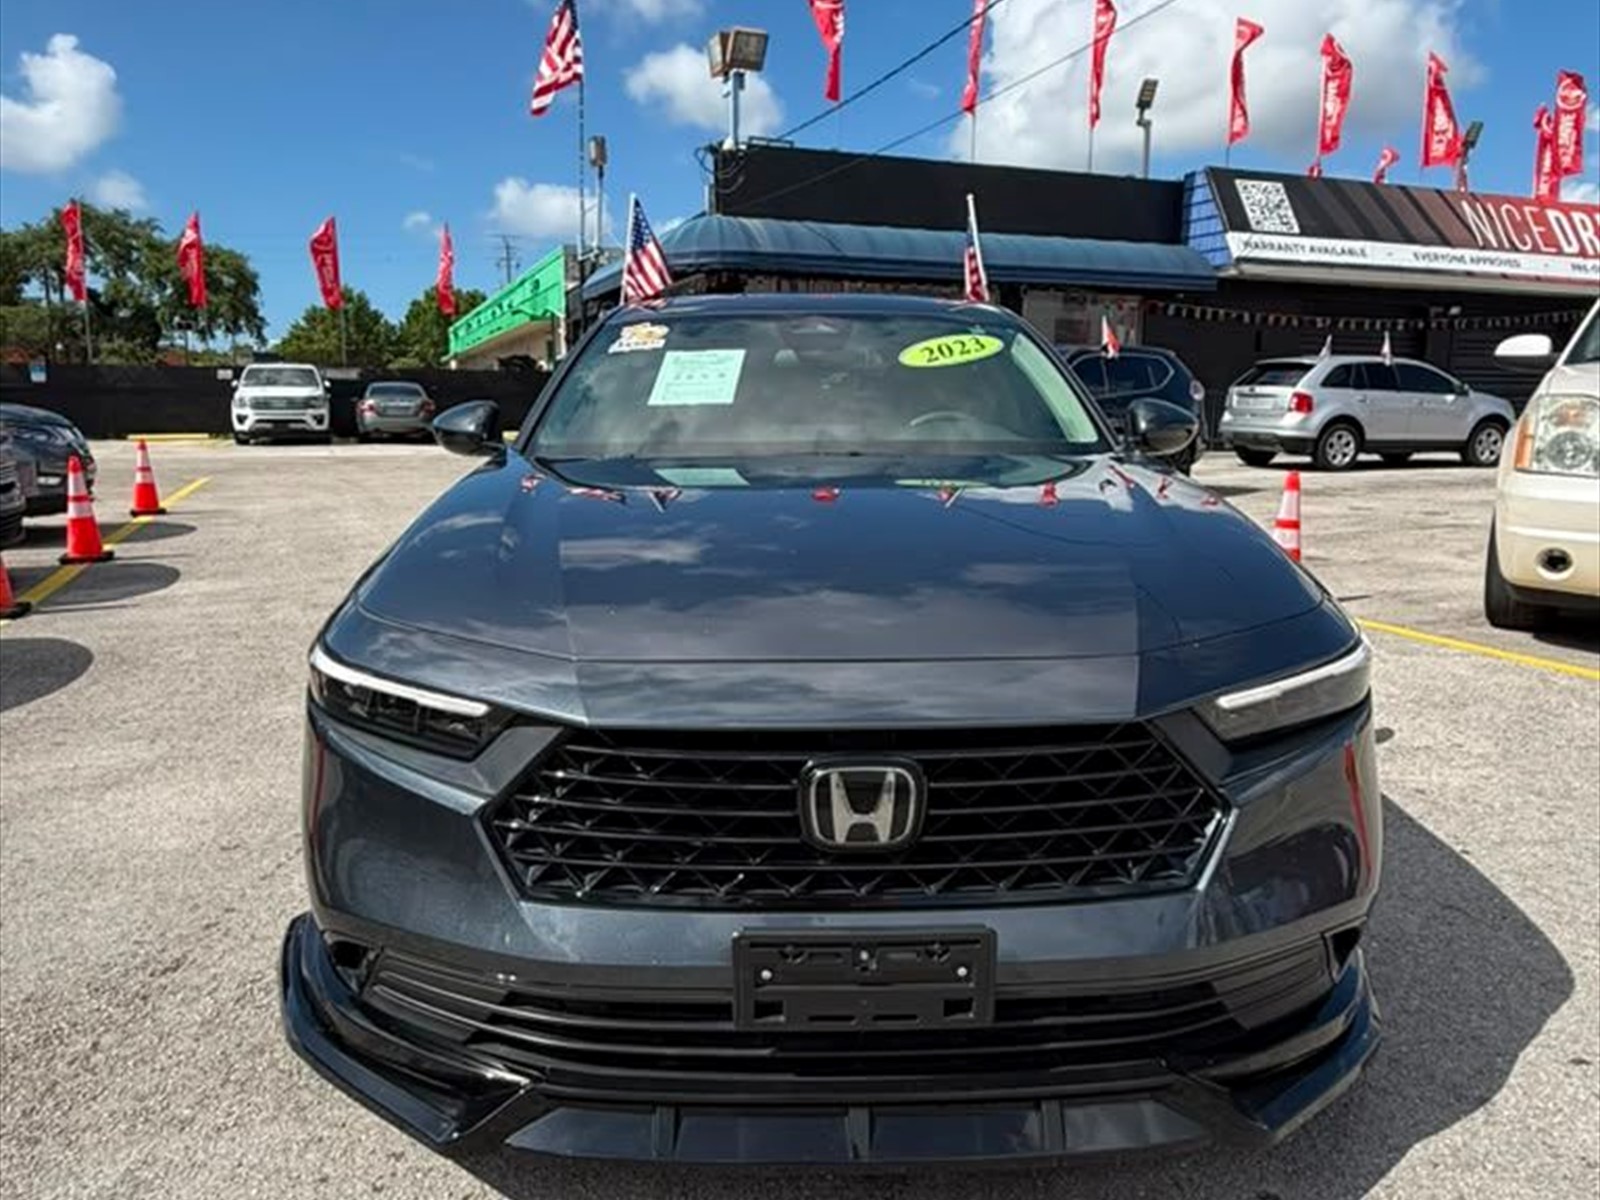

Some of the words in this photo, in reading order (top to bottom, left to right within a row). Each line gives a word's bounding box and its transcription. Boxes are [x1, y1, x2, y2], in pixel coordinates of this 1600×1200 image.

[1461, 200, 1600, 256] NICEDR
[1243, 240, 1306, 253] WARRANTY
[1309, 244, 1368, 258] AVAILABLE
[1413, 252, 1467, 265] EVERYONE
[1470, 255, 1521, 268] APPROVED
[920, 337, 986, 363] 2023
